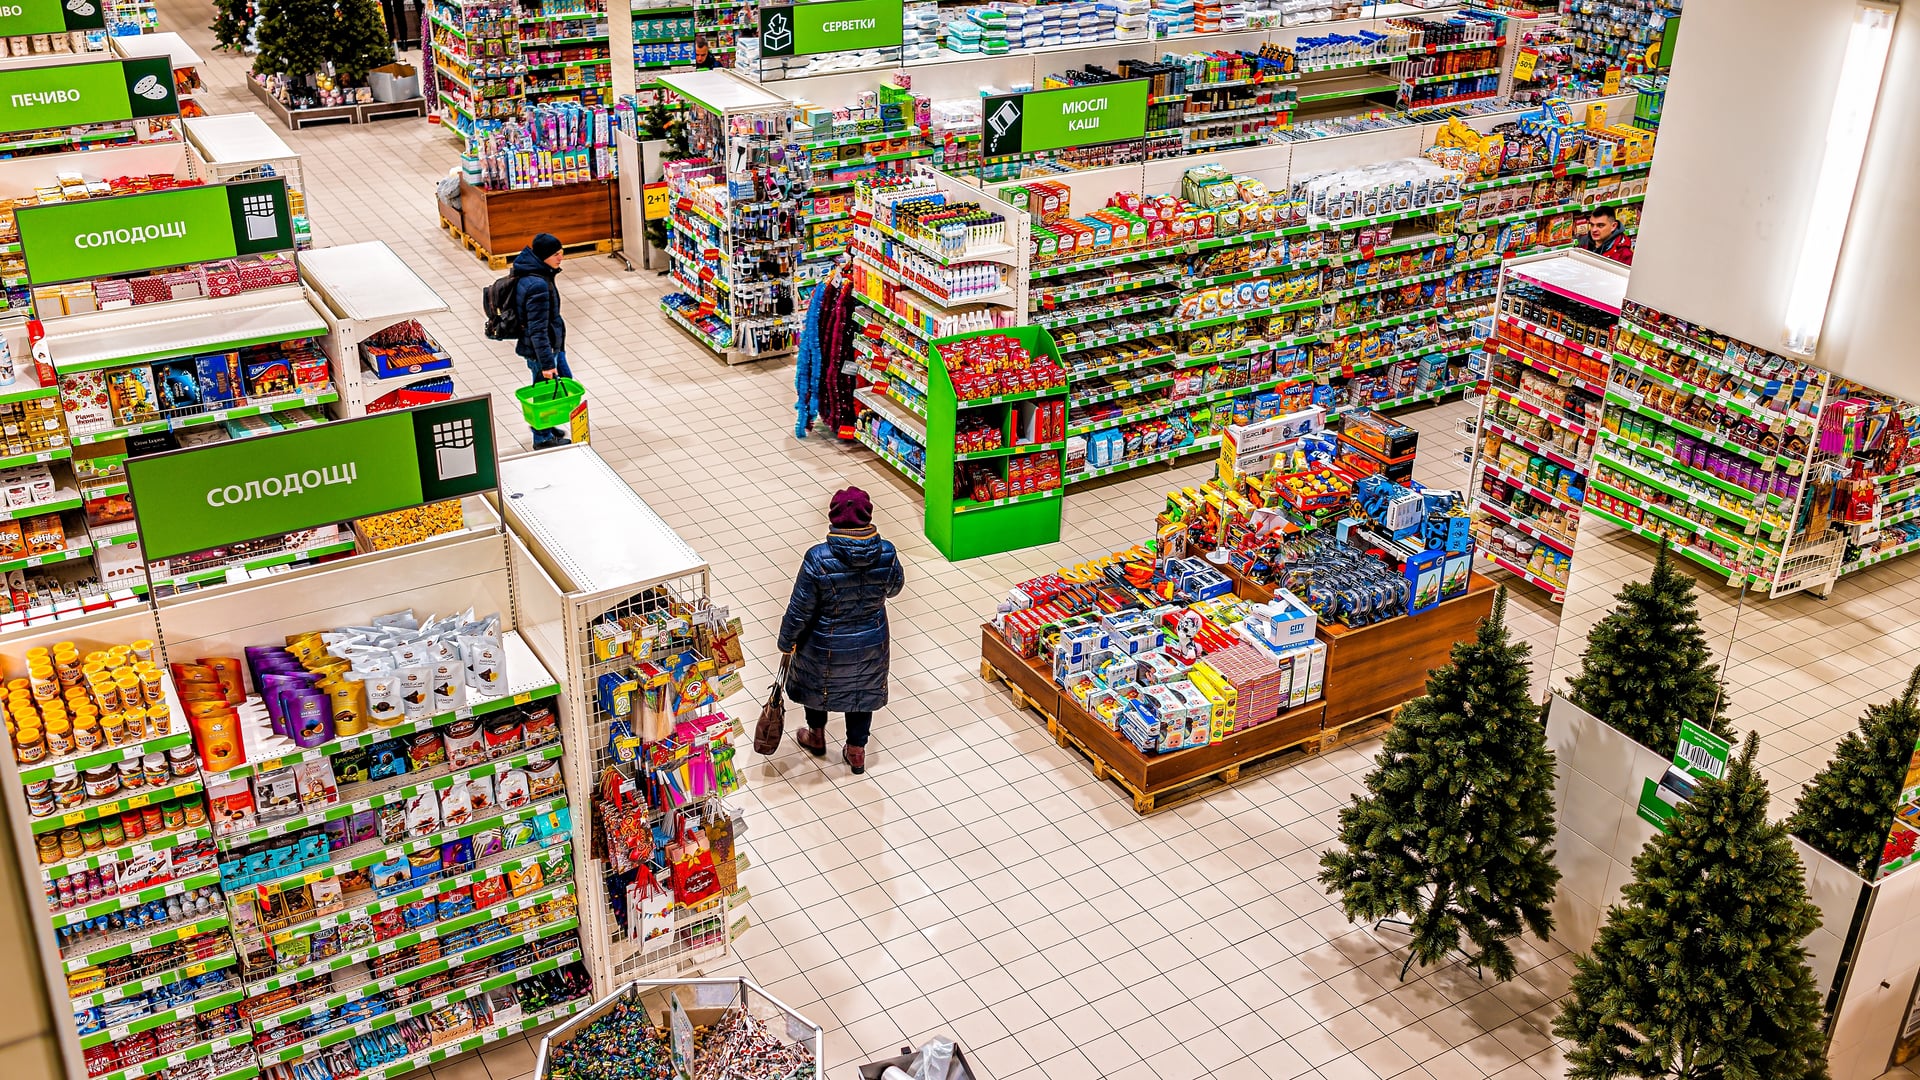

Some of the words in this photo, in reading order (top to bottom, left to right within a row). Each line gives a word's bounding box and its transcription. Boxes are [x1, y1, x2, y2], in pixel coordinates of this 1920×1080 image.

[822, 18, 876, 33] СЕРВЕТКИ
[11, 89, 80, 108] ПЕЧИВО
[1062, 98, 1108, 115] МЮСЛІ
[1068, 117, 1100, 131] КАШІ
[647, 193, 666, 205] 2+1
[74, 221, 187, 249] СОЛОДОЩІ
[207, 462, 357, 507] СОЛОДОЩІ
[1290, 623, 1305, 632] CITY
[607, 640, 618, 655] 0
[638, 640, 650, 656] 2
[615, 698, 631, 715] 2
[127, 861, 157, 876] bueno
[205, 1008, 225, 1019] LION
